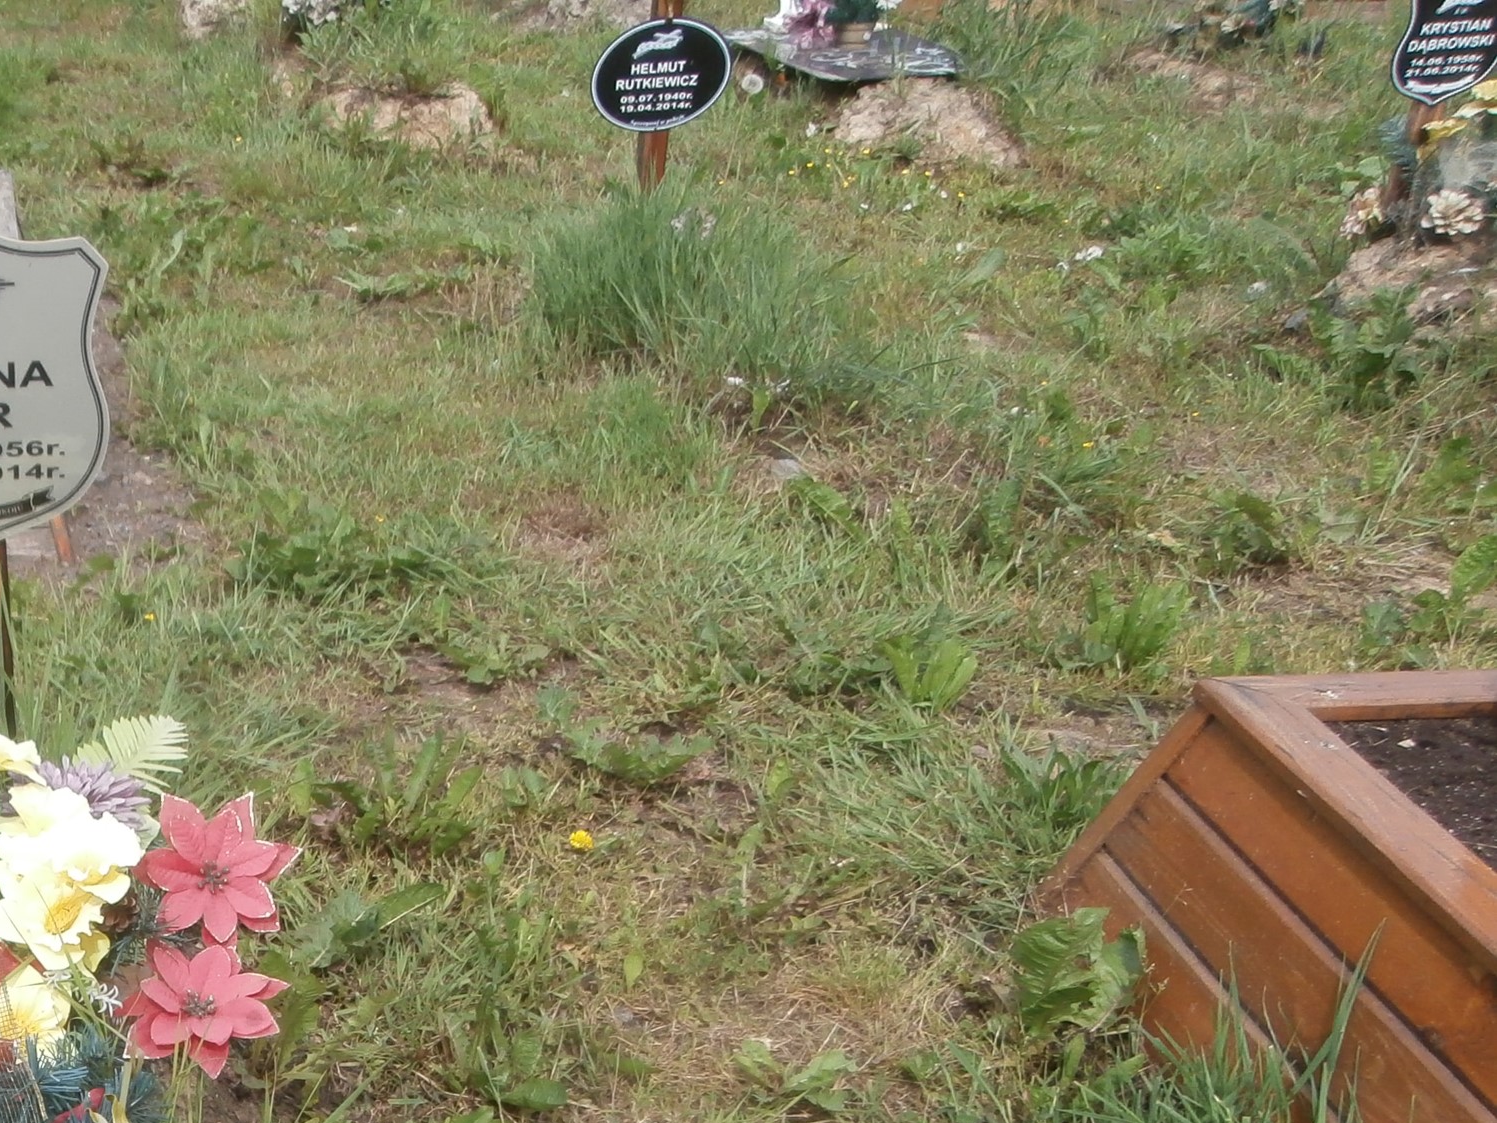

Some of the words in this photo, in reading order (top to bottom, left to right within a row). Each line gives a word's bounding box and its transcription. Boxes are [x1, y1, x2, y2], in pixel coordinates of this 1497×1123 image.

[1419, 19, 1493, 36] KRYSTIAN
[1406, 34, 1495, 54] DĄBROWSKI
[631, 60, 687, 75] HELMUT
[615, 74, 699, 91] RUTKIEWICZ
[619, 92, 693, 104] 09.07.1940r.
[619, 101, 692, 113] 19.04.2014r.
